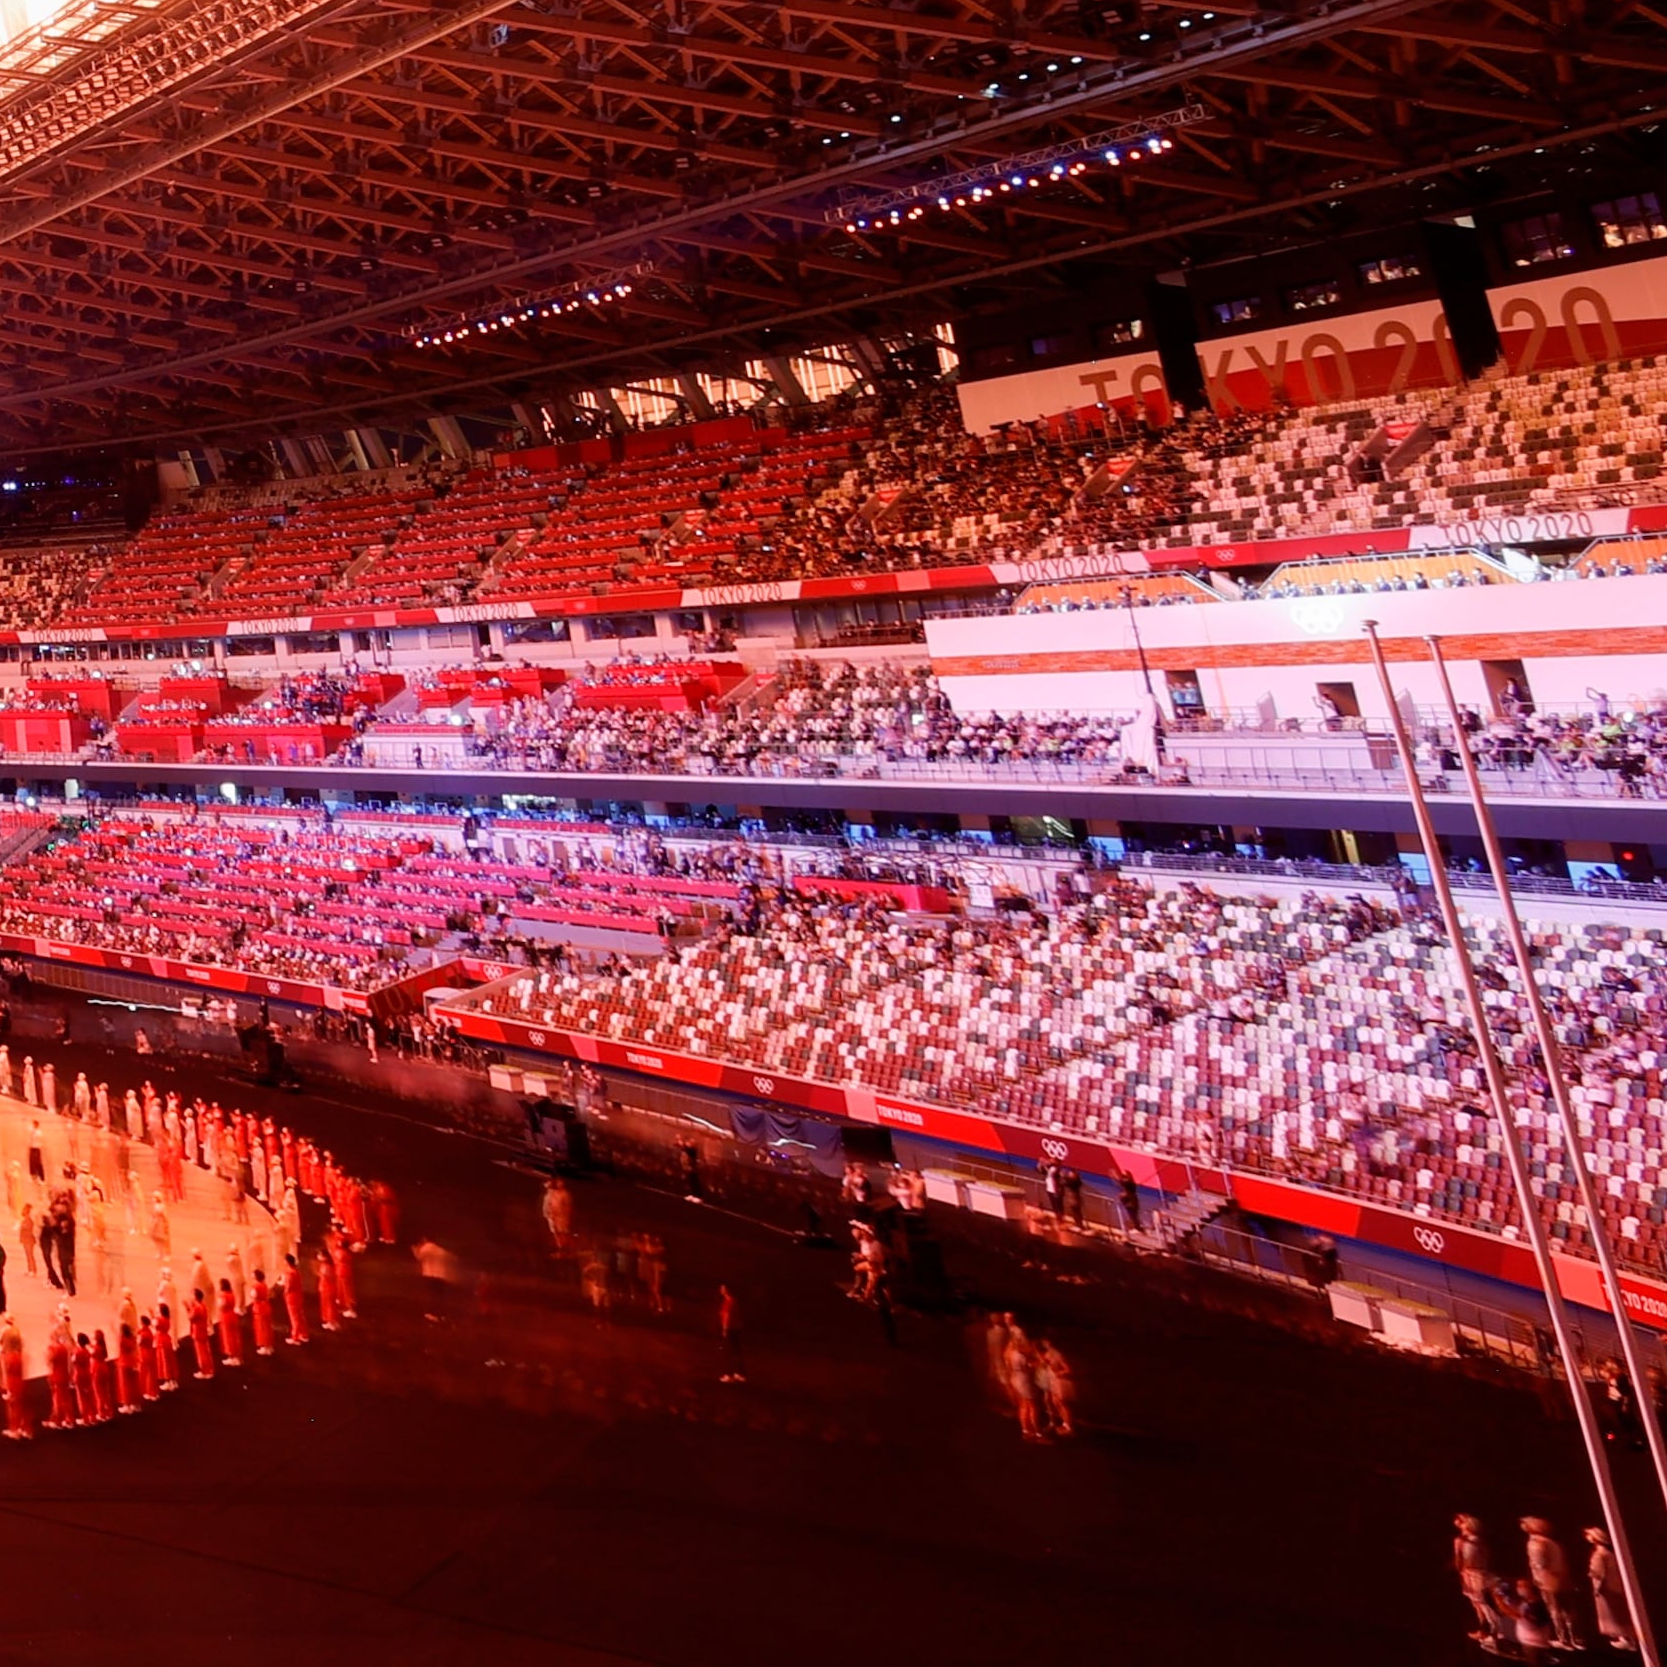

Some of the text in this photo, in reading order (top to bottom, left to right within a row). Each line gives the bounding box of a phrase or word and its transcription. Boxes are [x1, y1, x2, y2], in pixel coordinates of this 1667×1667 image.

[1078, 333, 1356, 430] TOKYO
[1439, 512, 1593, 546] TOKYO 2020
[1017, 554, 1124, 582] TOKYO 2020
[699, 583, 783, 606] TOKYO 2020
[451, 602, 518, 621] TOKYO 2020
[32, 628, 93, 642] TOKYO 2020
[240, 617, 299, 635] TOKYO 2020
[877, 1104, 923, 1125] TOKYO 2020
